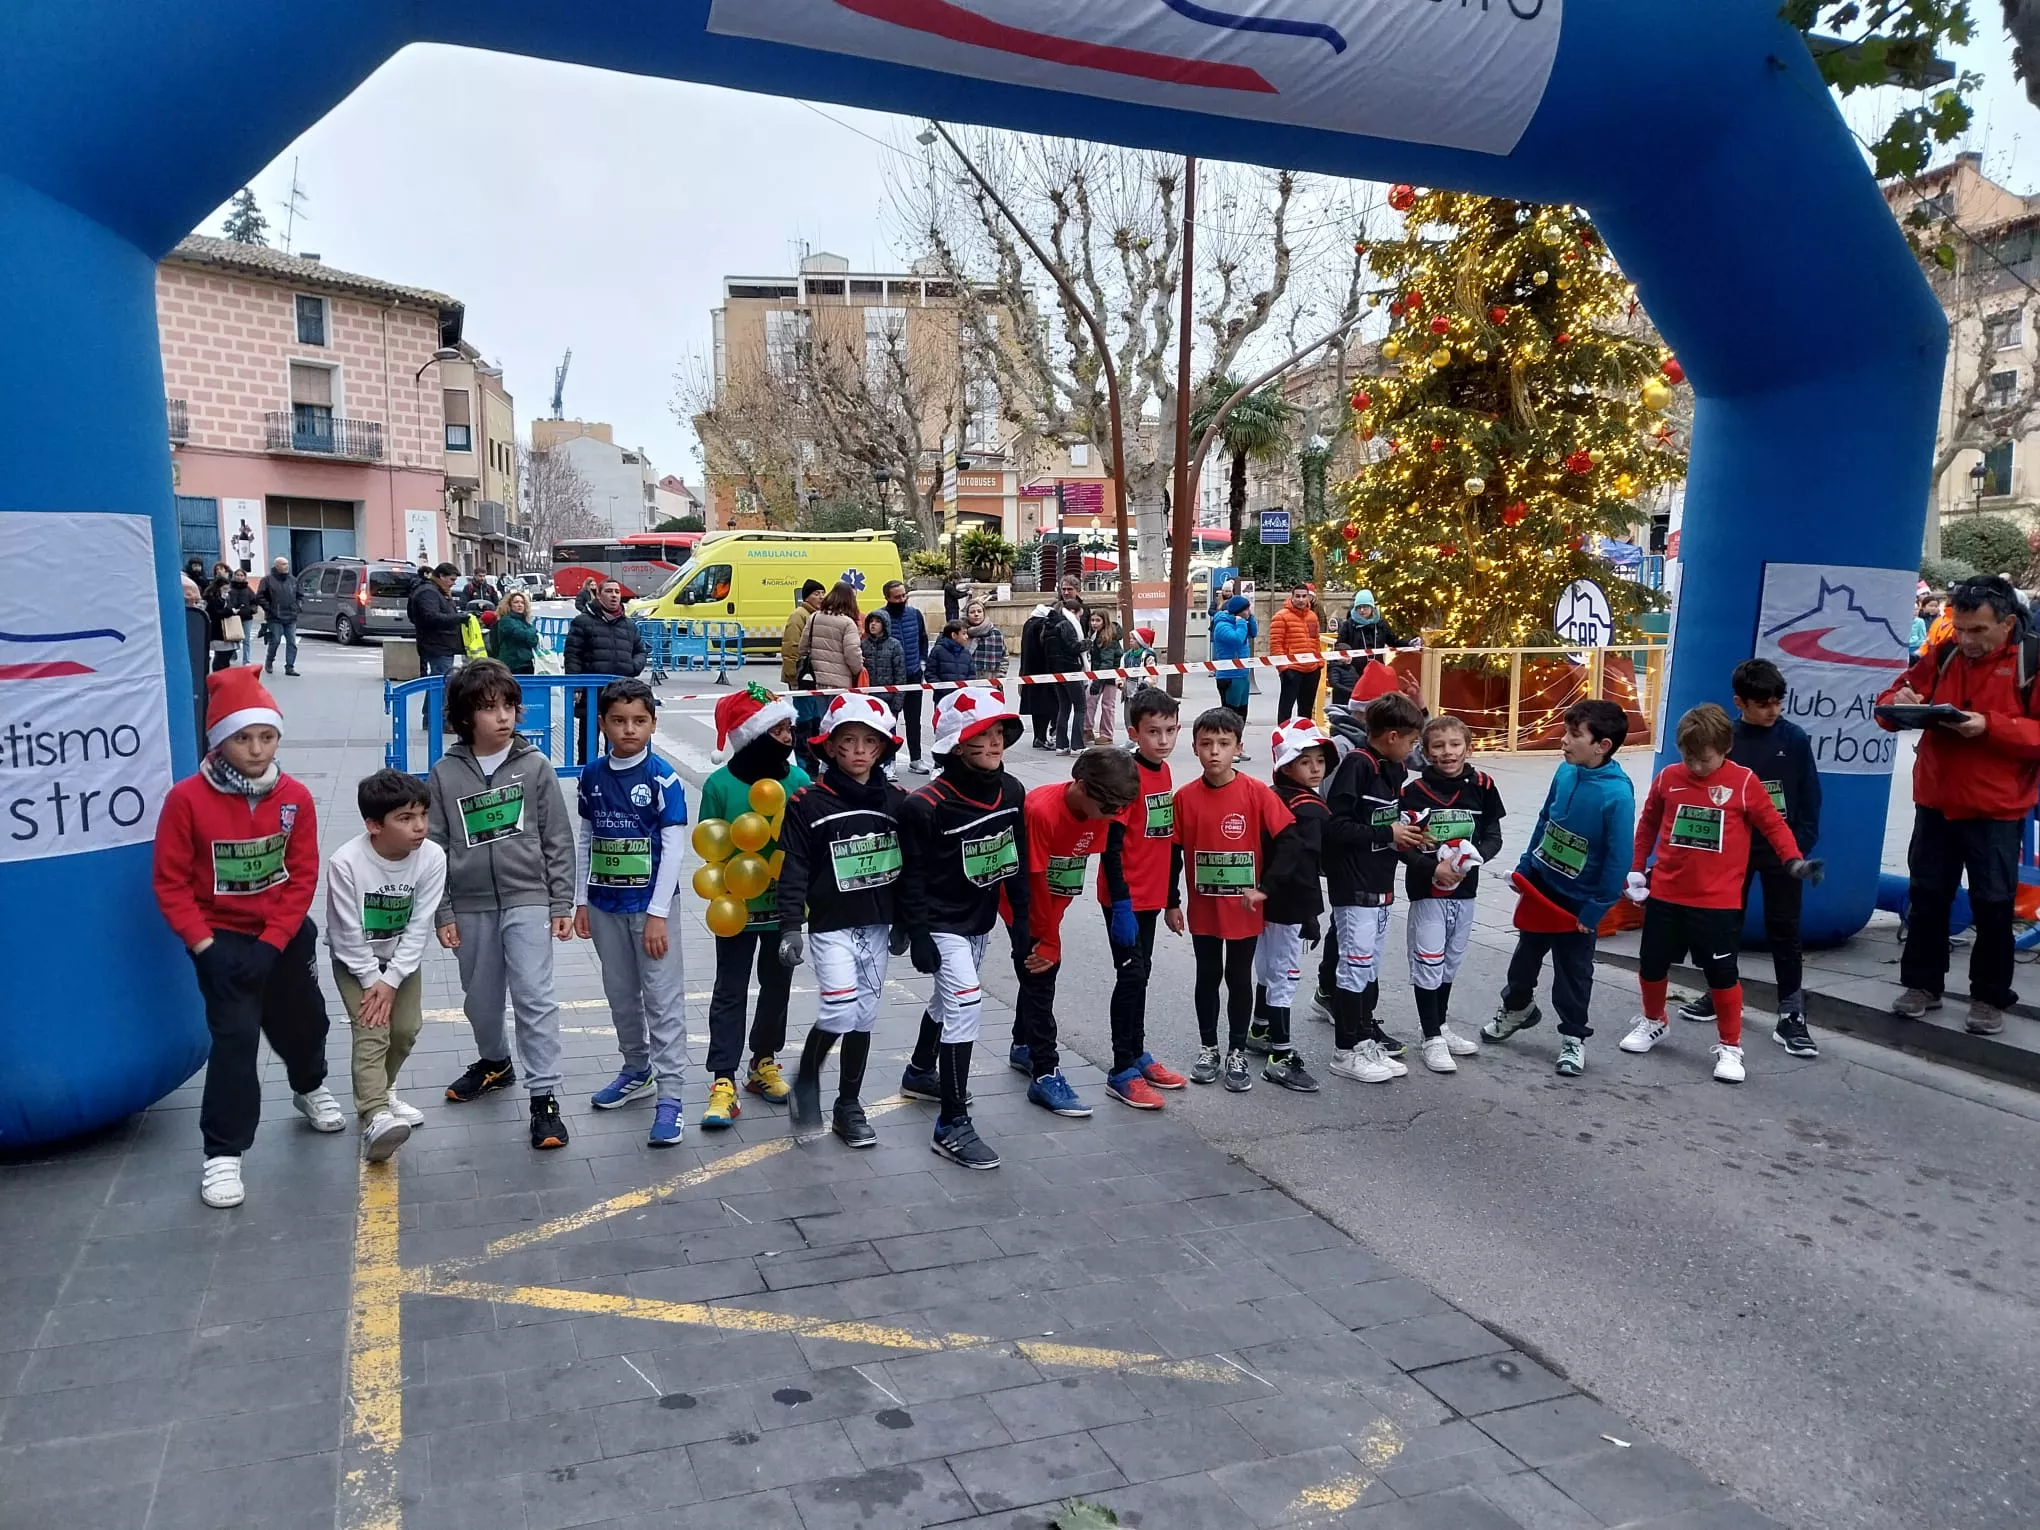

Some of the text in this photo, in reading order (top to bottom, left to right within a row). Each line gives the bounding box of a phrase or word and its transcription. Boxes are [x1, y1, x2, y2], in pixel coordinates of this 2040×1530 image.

[957, 477, 996, 486] AUTOBUSES
[747, 550, 808, 558] AMBULANCIA
[1137, 590, 1166, 599] cosmia
[1780, 687, 1836, 718] lub
[1808, 727, 1897, 764] rbas
[9, 781, 145, 841] stro
[486, 810, 504, 823] 95
[1435, 825, 1450, 834] 73
[1688, 823, 1711, 834] 139
[627, 840, 649, 852] 2024
[834, 835, 897, 856] SAN SILVESTRE 2024
[965, 845, 978, 856] SAN
[979, 837, 1002, 853] SILVESTRE
[605, 856, 620, 867] 89
[858, 855, 874, 868] 77
[984, 854, 998, 866] 78
[1208, 853, 1233, 865] SILVESTRE
[1233, 852, 1253, 865] 2024
[242, 860, 262, 872] 39
[1047, 870, 1063, 879] 27
[1217, 868, 1225, 878] 4
